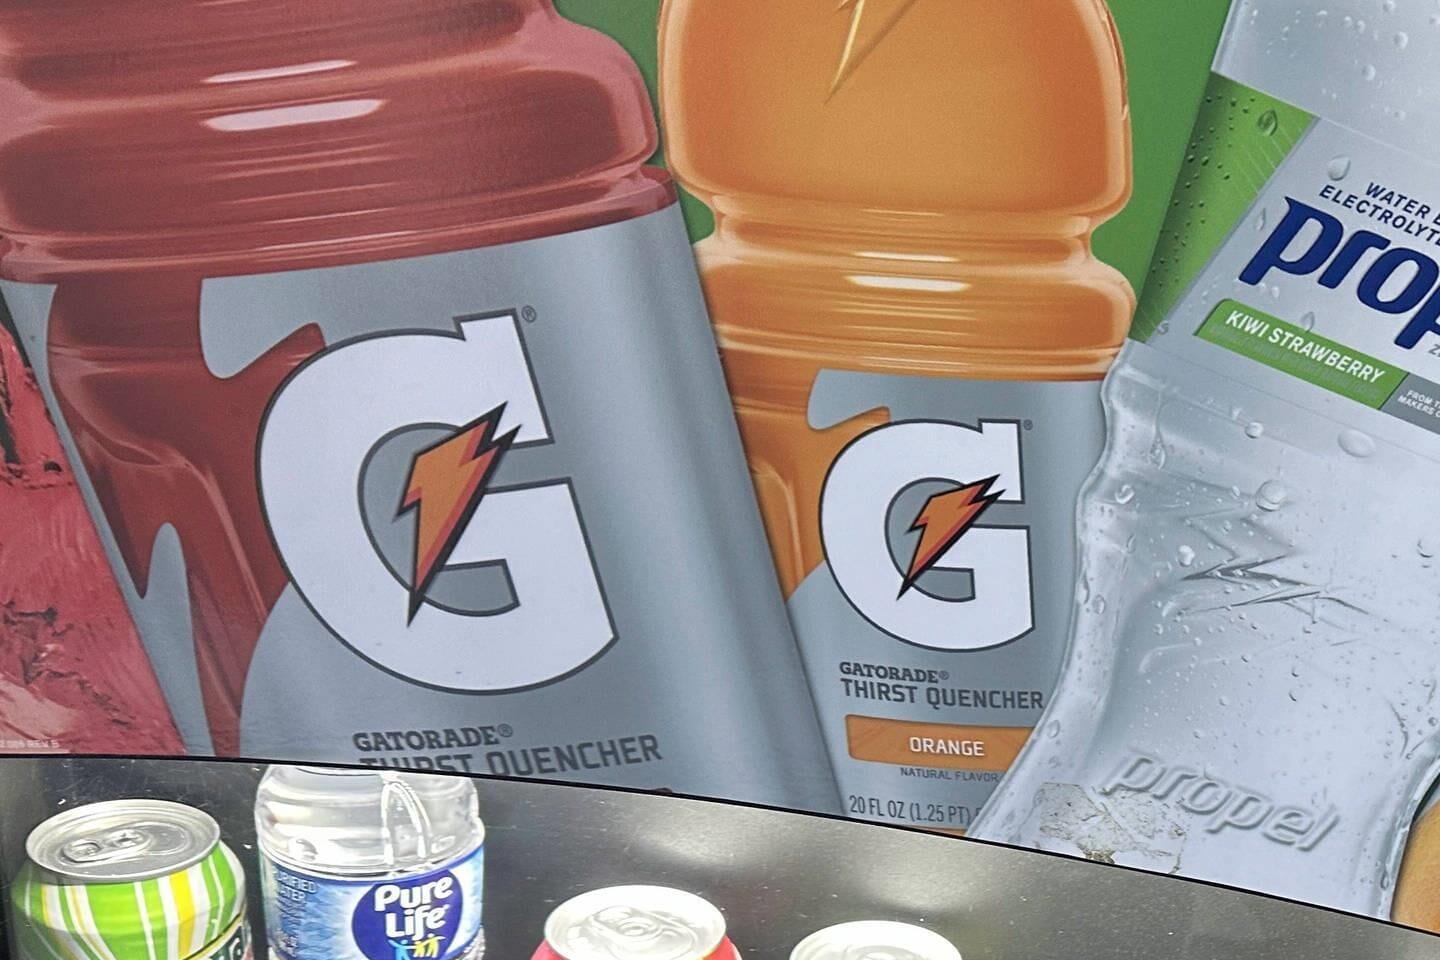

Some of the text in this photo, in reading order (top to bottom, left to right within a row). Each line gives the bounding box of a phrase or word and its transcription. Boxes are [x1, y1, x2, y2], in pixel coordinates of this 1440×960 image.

[1366, 182, 1431, 219] WATER
[1225, 309, 1386, 384] KIWI STRAWBERRY
[1397, 394, 1436, 417] MAKERS
[1406, 389, 1434, 408] FROM
[840, 677, 1044, 710] THIRST QUENCHER
[485, 734, 663, 777] QUENCHER
[909, 736, 985, 757] ORANGE
[900, 767, 951, 781] NATURAL
[849, 795, 866, 814] 20
[869, 798, 885, 817] FL
[887, 800, 906, 819] OZ
[910, 802, 944, 823] (1.25
[948, 805, 971, 827] PT)
[1099, 756, 1340, 852] propel
[375, 876, 453, 912] Pure
[385, 906, 447, 941] Life
